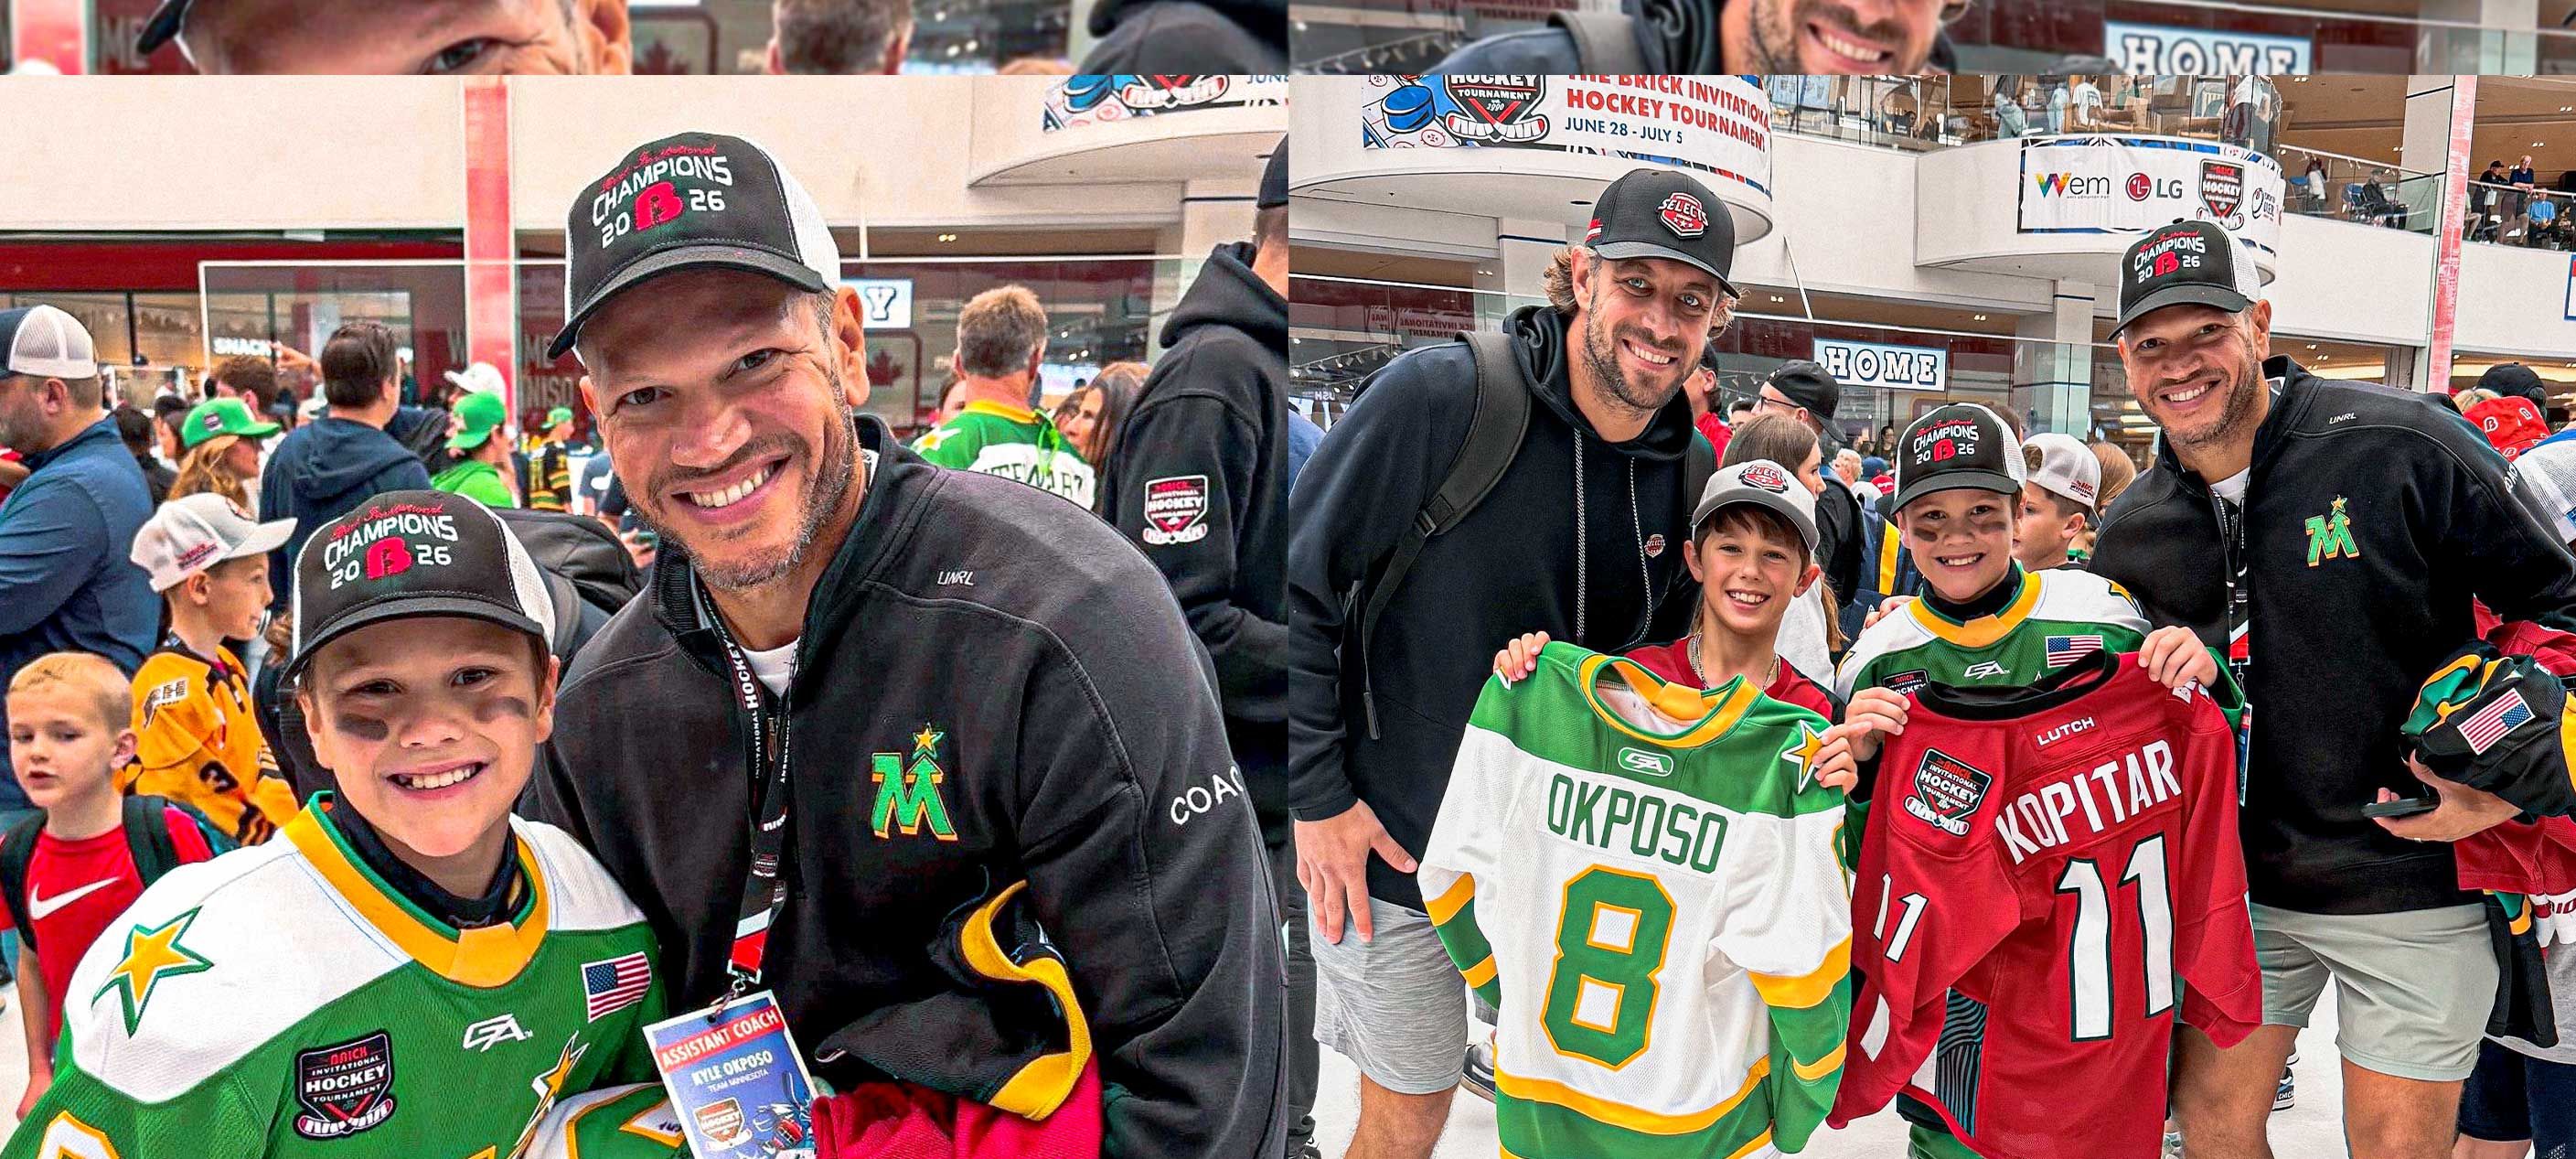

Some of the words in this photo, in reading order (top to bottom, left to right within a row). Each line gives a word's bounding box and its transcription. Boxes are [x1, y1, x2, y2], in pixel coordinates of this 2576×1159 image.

[1450, 75, 1537, 87] HOCKEY
[1457, 89, 1532, 101] TOURNAMENT
[1566, 88, 1663, 119] HOCKEY
[1565, 117, 1606, 134] JUNE
[1609, 122, 1629, 136] 28
[1640, 126, 1673, 144] JULY
[1676, 131, 1683, 145] 5
[593, 156, 733, 228] CHAMPIONS
[2156, 177, 2184, 199] LG
[2202, 180, 2240, 197] HOCKEY
[601, 211, 631, 250] 20
[689, 188, 726, 212] 26
[1657, 199, 1709, 227] SELECTS
[2133, 236, 2207, 273] CHAMPIONS
[2137, 264, 2154, 284] 20
[2182, 254, 2201, 268] 26
[1824, 345, 1938, 385] HOME
[2328, 412, 2357, 425] UNRL
[1913, 424, 1980, 454] CHAMPIONS
[1916, 449, 1931, 466] 20
[1957, 443, 1976, 456] 26
[1148, 496, 1204, 512] HOCKEY
[324, 514, 459, 573] CHAMPIONS
[330, 559, 360, 591] 20
[414, 543, 453, 566] 26
[936, 570, 975, 586] UNRL
[724, 638, 760, 711] HOCKEY
[2036, 716, 2096, 746] LUTCH
[1919, 769, 1980, 804] HOCKEY
[1929, 764, 1978, 791] INVITATIONAL
[1921, 784, 1970, 810] TOURNAMENT
[1994, 738, 2183, 866] KOPITAR
[1547, 772, 1730, 875] OKPOSO
[1872, 871, 1930, 965] 11
[2054, 831, 2175, 1043] 11
[1539, 864, 1679, 1072] 8
[661, 1027, 732, 1069] ASSISTANT
[732, 1010, 780, 1039] COACH
[305, 1062, 388, 1094] HOCKEY
[312, 1054, 381, 1077] INVITATIONAL
[690, 1064, 721, 1086] KYLE
[722, 1049, 775, 1077] OKPOSO
[313, 1082, 382, 1103] TOURNAMENT
